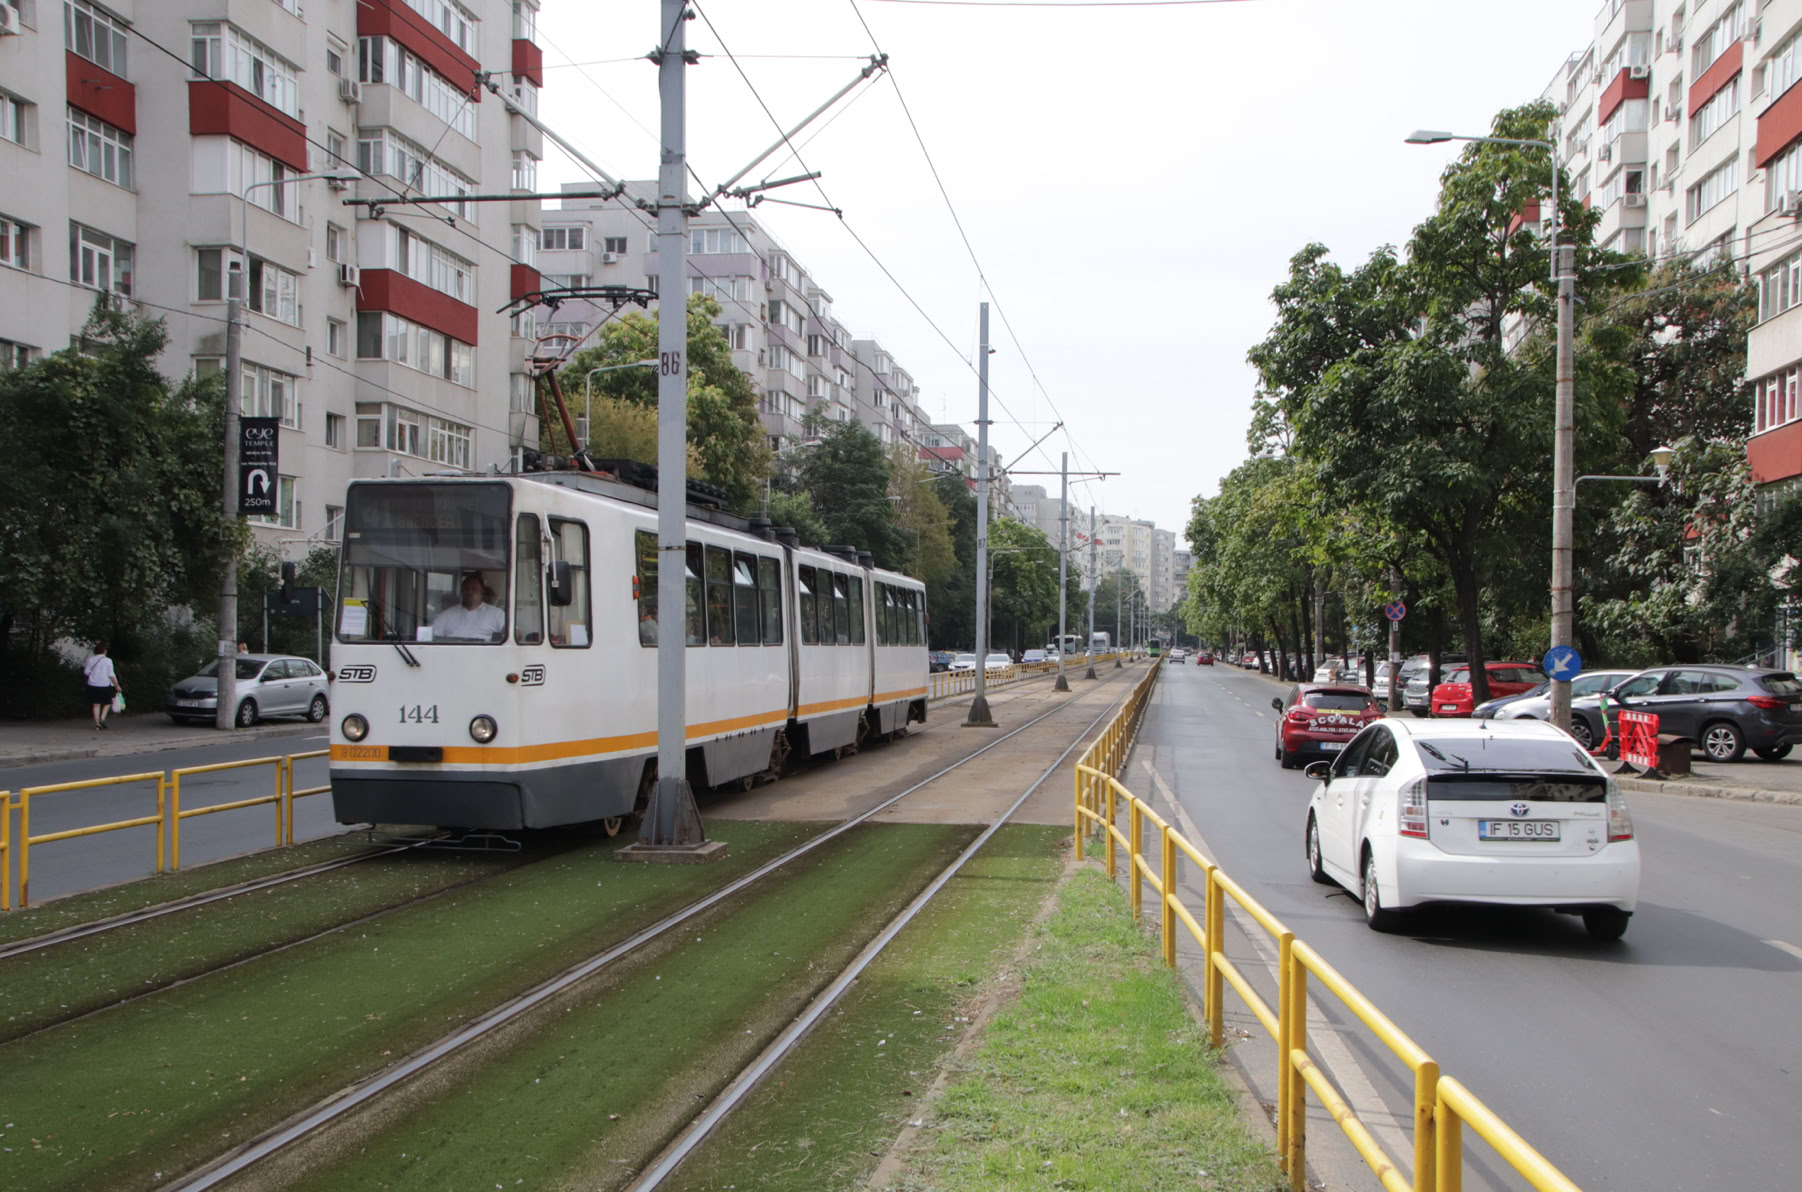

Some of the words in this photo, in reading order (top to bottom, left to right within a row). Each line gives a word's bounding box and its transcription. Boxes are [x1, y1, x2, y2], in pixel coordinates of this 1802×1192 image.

[661, 352, 680, 376] 86
[245, 427, 274, 440] eye
[244, 498, 271, 506] 250m
[338, 666, 374, 681] STB
[521, 667, 545, 684] STB
[399, 704, 439, 724] 144
[1490, 823, 1502, 836] IF
[1508, 823, 1520, 836] 15
[1524, 823, 1554, 836] GUS
